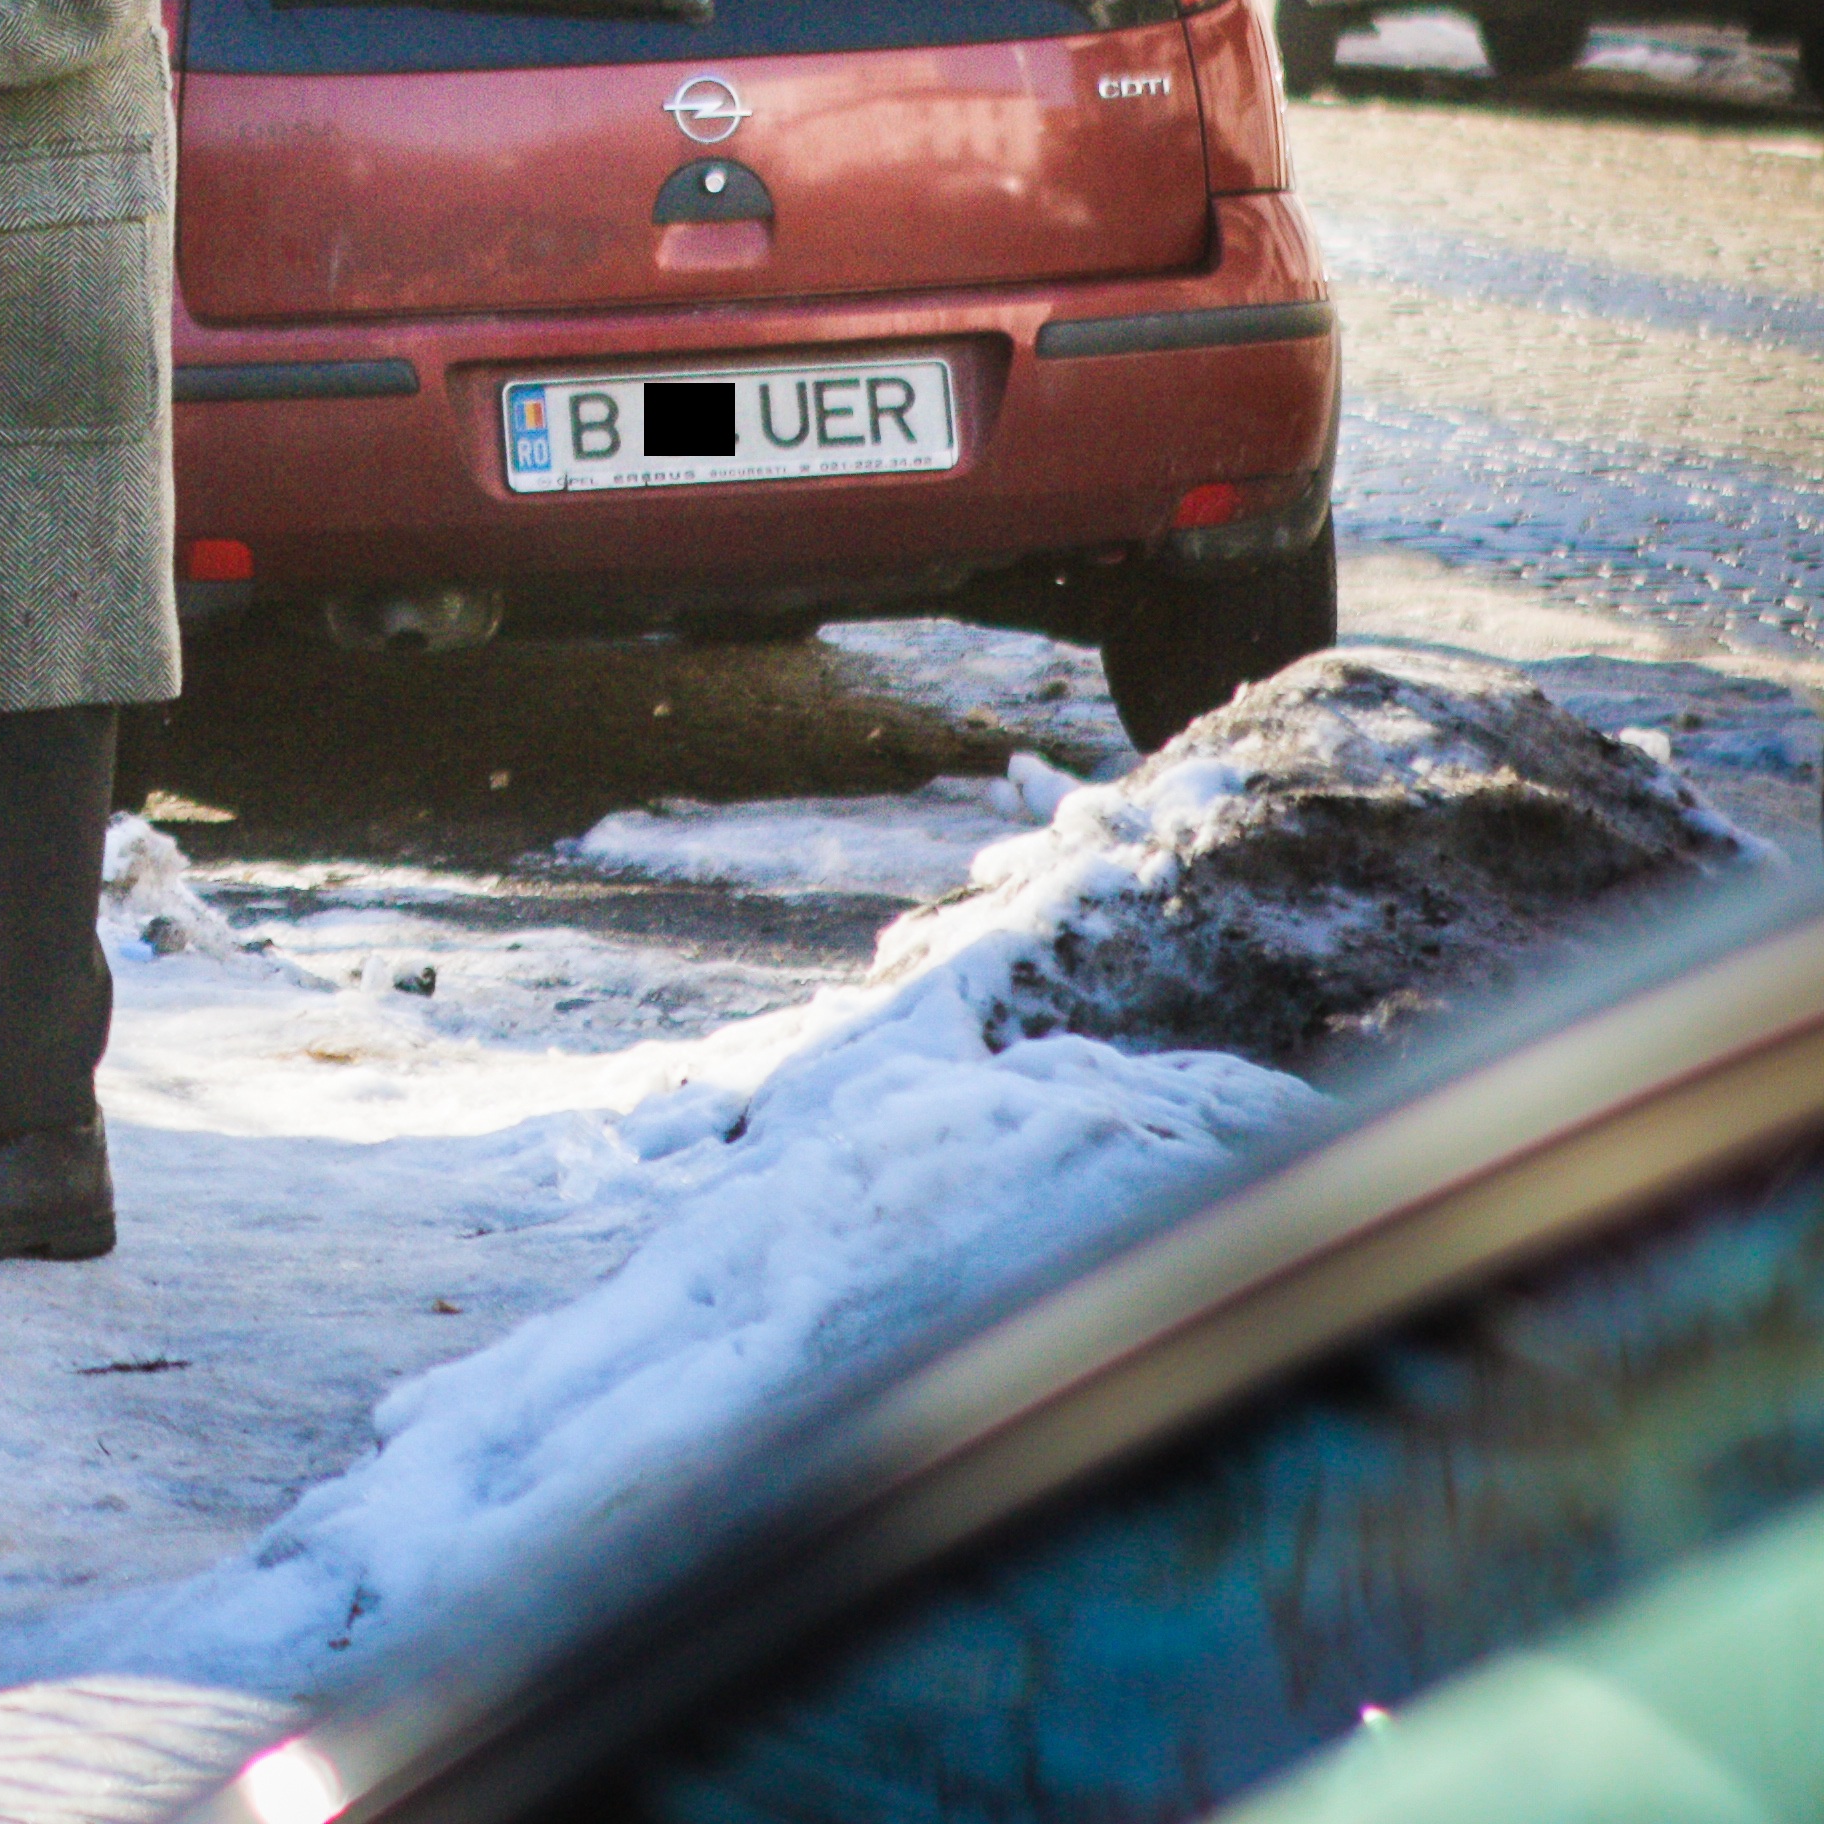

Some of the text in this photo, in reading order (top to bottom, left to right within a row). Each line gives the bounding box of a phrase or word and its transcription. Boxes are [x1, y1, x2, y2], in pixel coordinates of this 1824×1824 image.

[568, 390, 622, 463] B
[759, 376, 918, 450] UER
[517, 439, 549, 467] RO
